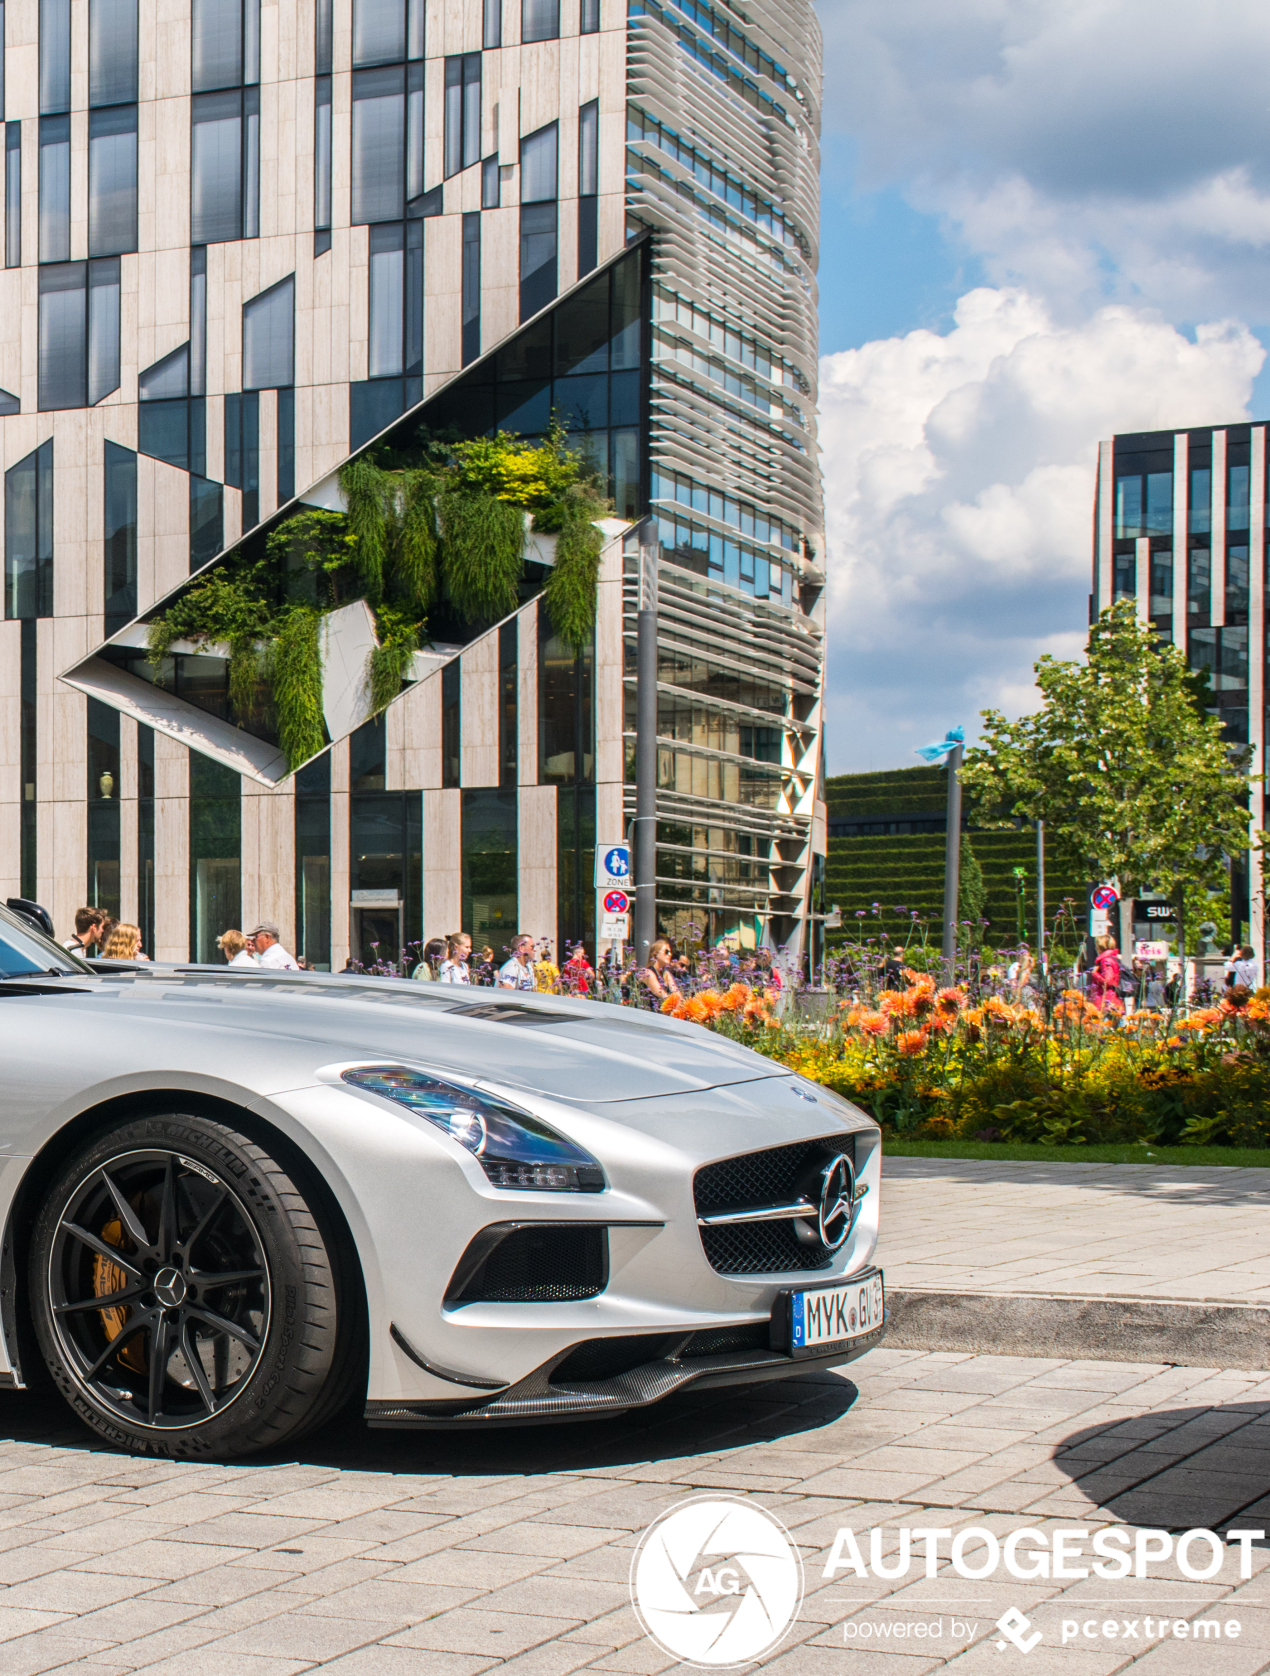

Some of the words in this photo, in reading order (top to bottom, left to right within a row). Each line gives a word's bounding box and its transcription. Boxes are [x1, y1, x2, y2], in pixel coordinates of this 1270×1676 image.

[606, 878, 629, 886] ZONE
[480, 921, 517, 930] ROLEX
[166, 1125, 247, 1177] MICHELIN
[285, 1284, 297, 1325] Pilot
[806, 1292, 848, 1339] MYK
[858, 1286, 871, 1328] GV
[275, 1325, 293, 1371] Sport
[795, 1326, 802, 1338] D
[263, 1371, 280, 1396] Cup
[255, 1396, 266, 1409] 2
[74, 1398, 148, 1452] MICHELIN
